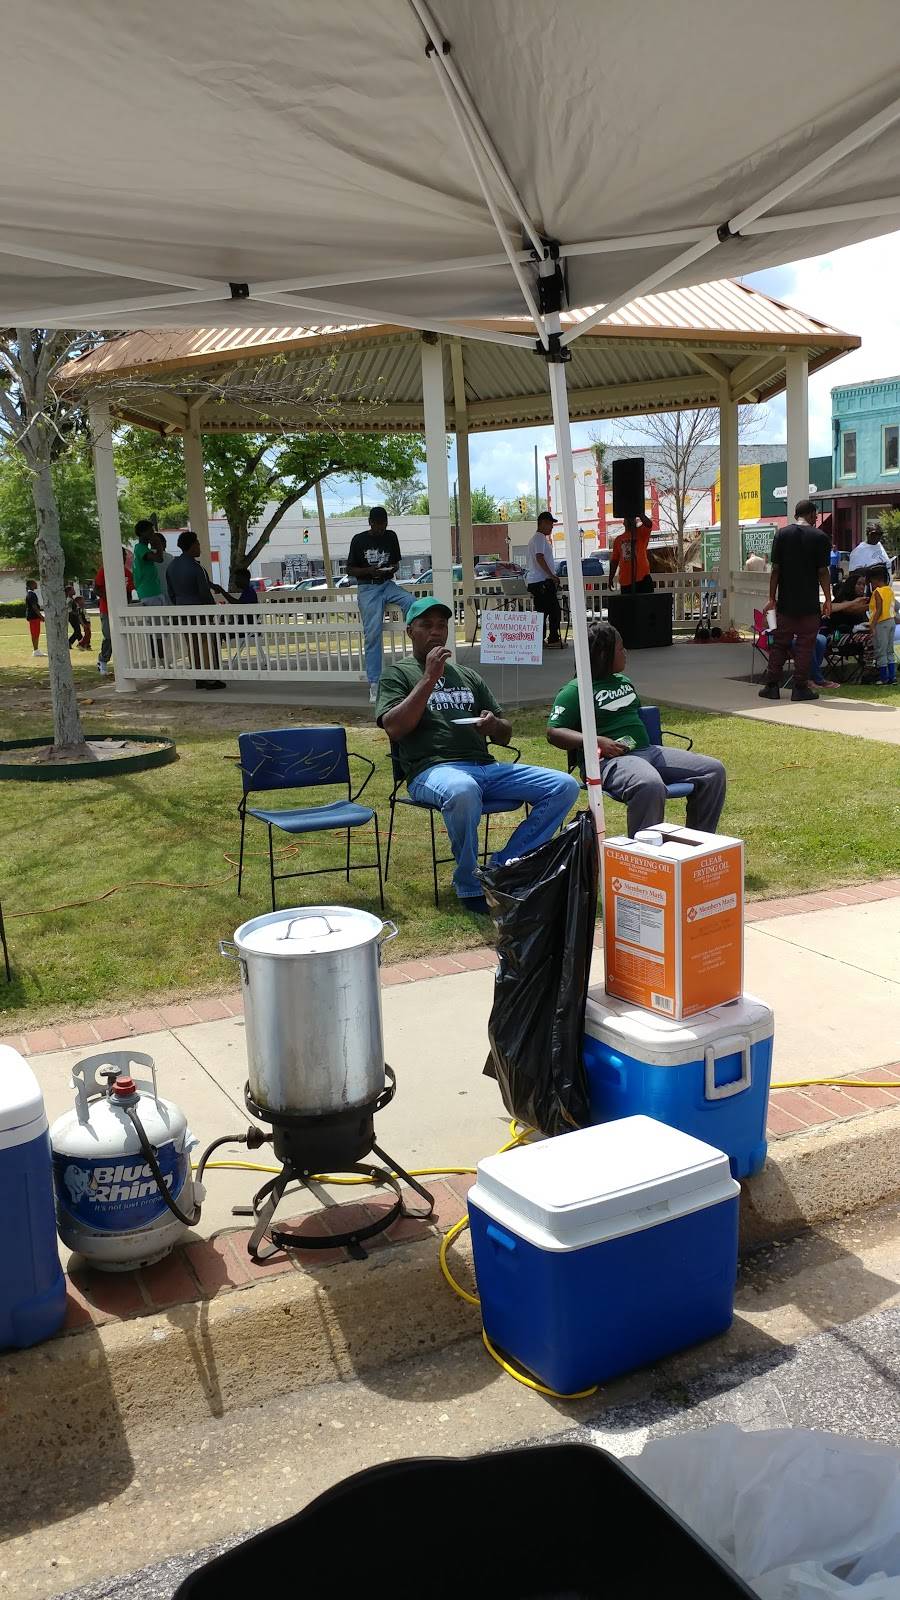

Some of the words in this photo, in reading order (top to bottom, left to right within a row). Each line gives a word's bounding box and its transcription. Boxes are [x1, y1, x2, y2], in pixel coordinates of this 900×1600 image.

[745, 532, 771, 541] REPORT
[745, 539, 772, 547] WILDLIFE
[503, 613, 527, 622] CARVER
[485, 622, 540, 632] COMMEMORATIVE
[500, 631, 535, 643] Festival
[430, 702, 473, 712] FOOTBAL
[606, 849, 629, 862] CLEAR
[630, 855, 658, 871] FRYING
[658, 863, 672, 873] OIL
[700, 855, 722, 868] CLEAR
[693, 862, 718, 879] FRYING
[718, 861, 730, 872] OIL
[93, 1160, 160, 1184] Blue
[88, 1172, 174, 1202] Rhino
[108, 1204, 121, 1212] not
[122, 1201, 140, 1210] just
